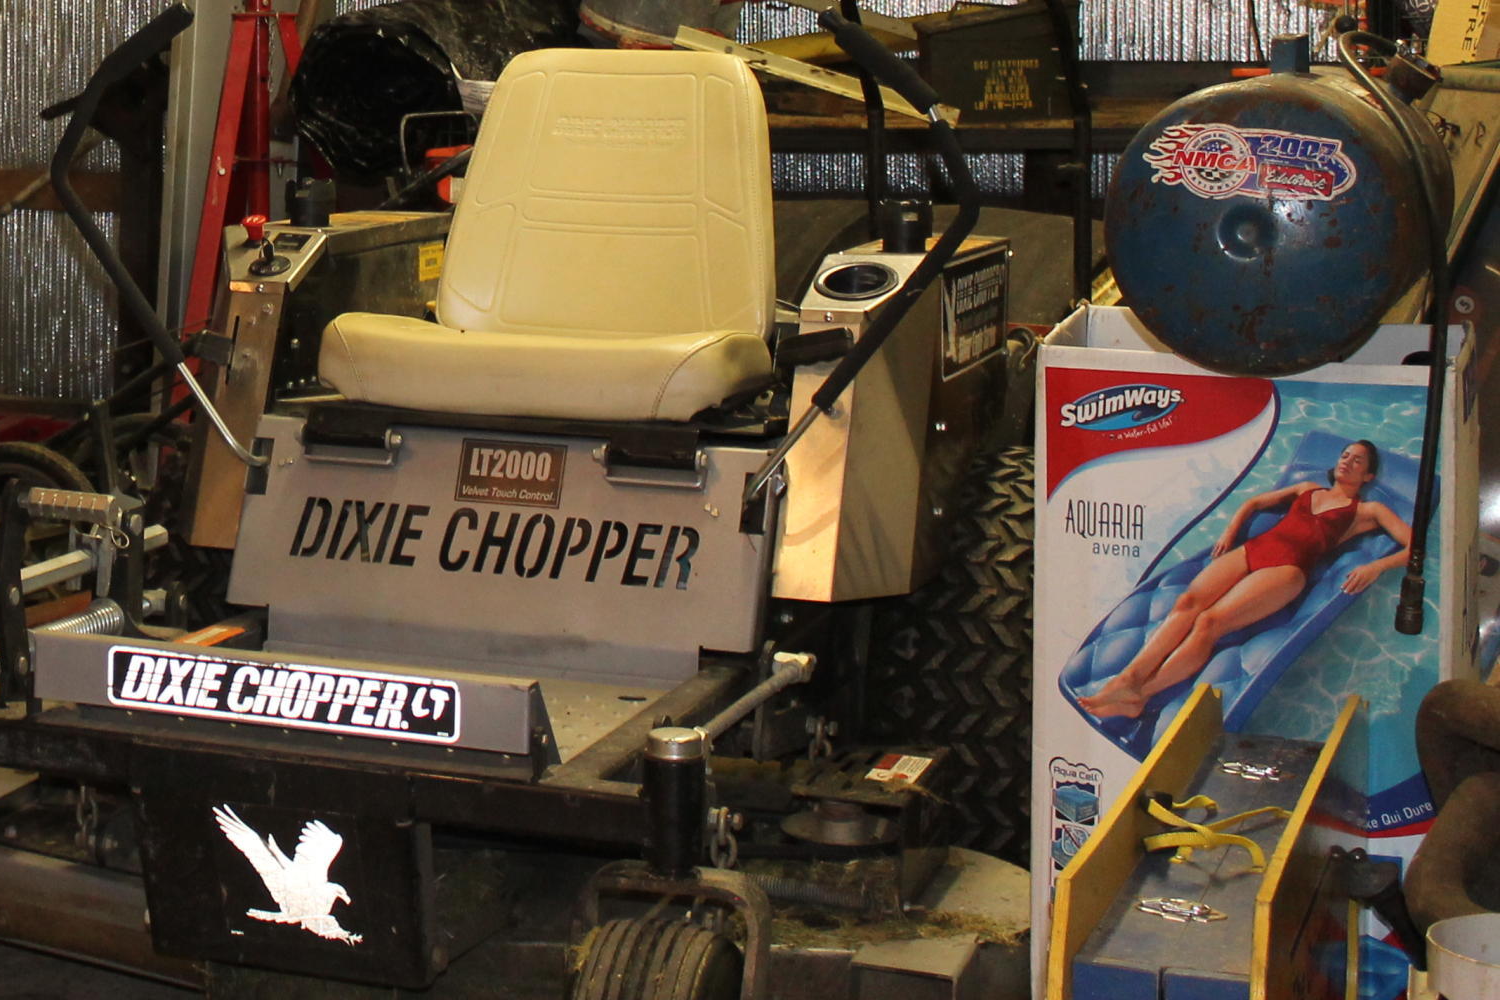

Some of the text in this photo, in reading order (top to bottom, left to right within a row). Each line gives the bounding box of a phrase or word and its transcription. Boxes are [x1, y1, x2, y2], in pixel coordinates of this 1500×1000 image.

[1173, 151, 1257, 173] NMCA
[1060, 388, 1181, 427] SwimWays
[469, 447, 552, 482] LT2000
[462, 484, 489, 497] Velvet
[491, 487, 518, 500] Touch
[1065, 498, 1143, 541] AQUARIA
[289, 497, 700, 590] DIXIE CHOPPER
[1092, 542, 1141, 558] avena
[120, 654, 228, 710] DIXIE
[411, 686, 450, 721] LT
[1053, 766, 1098, 781] Aqua Cell
[1381, 812, 1402, 826] Qui
[1402, 802, 1434, 821] Dure
